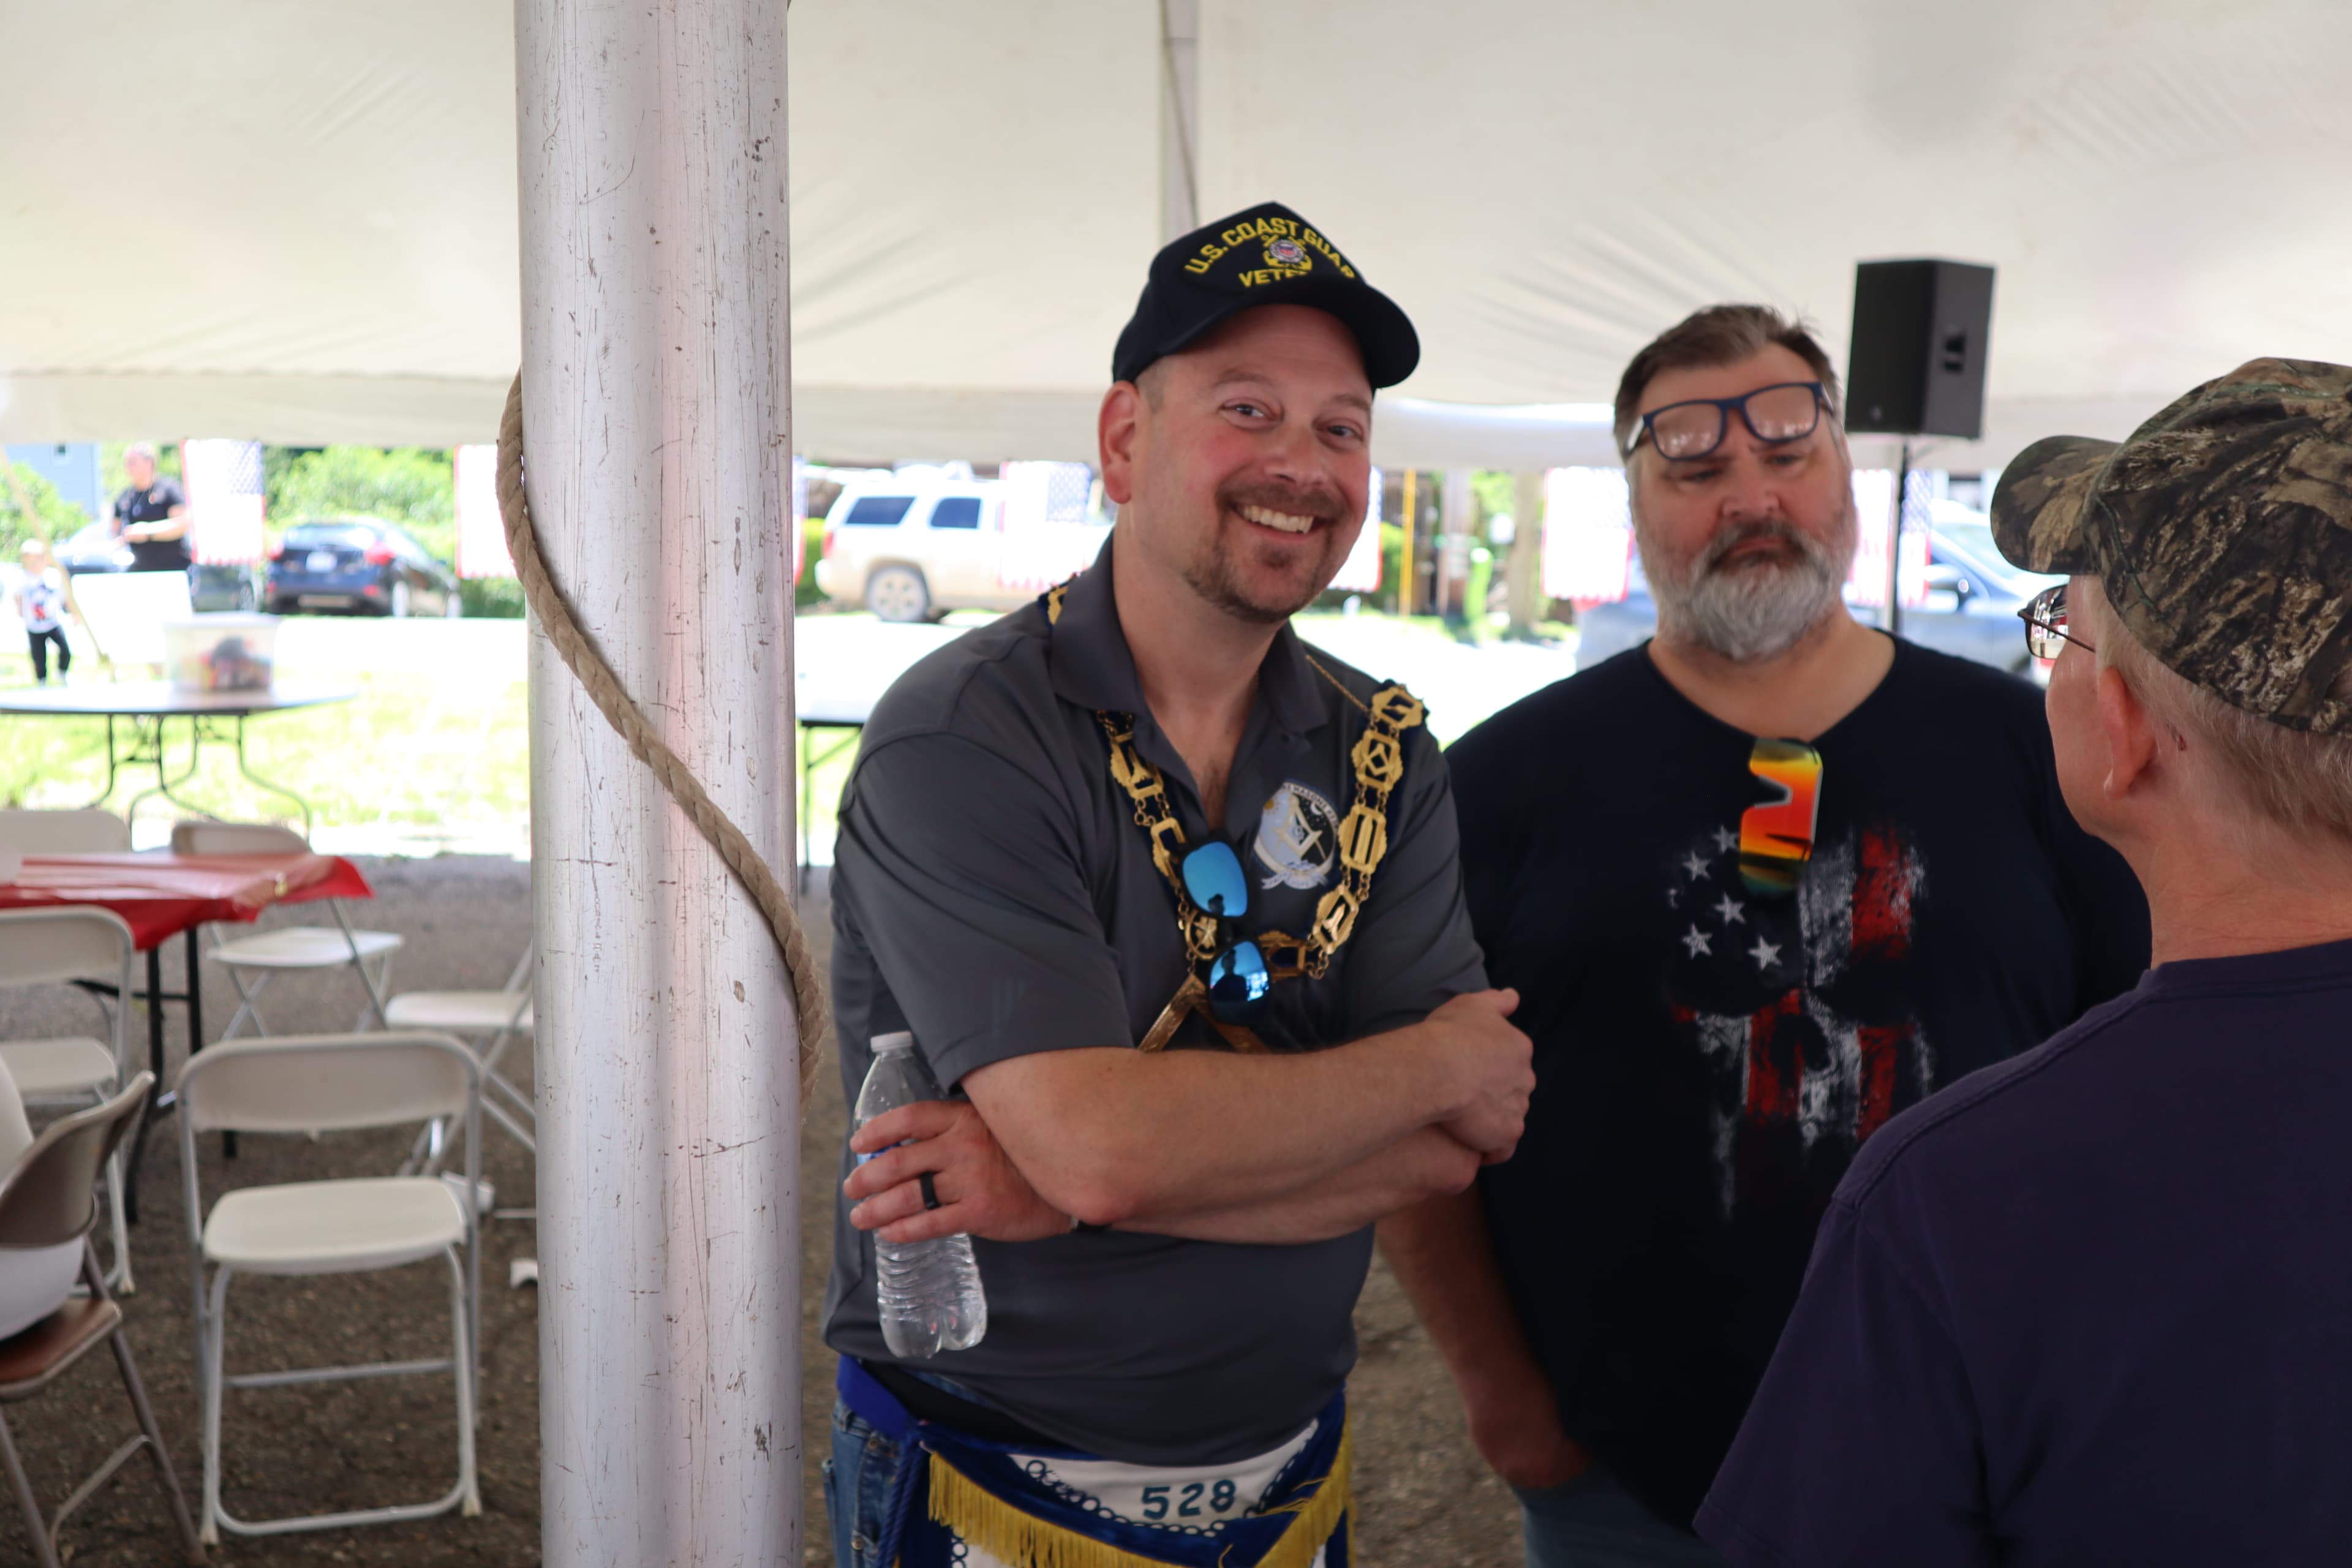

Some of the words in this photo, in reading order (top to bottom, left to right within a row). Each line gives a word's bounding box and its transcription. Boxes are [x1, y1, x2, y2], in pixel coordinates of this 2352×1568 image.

[1184, 243, 1229, 274] U.S.
[1221, 217, 1300, 246] COAST
[1303, 227, 1355, 279] GUAR
[1141, 1479, 1236, 1520] 528
